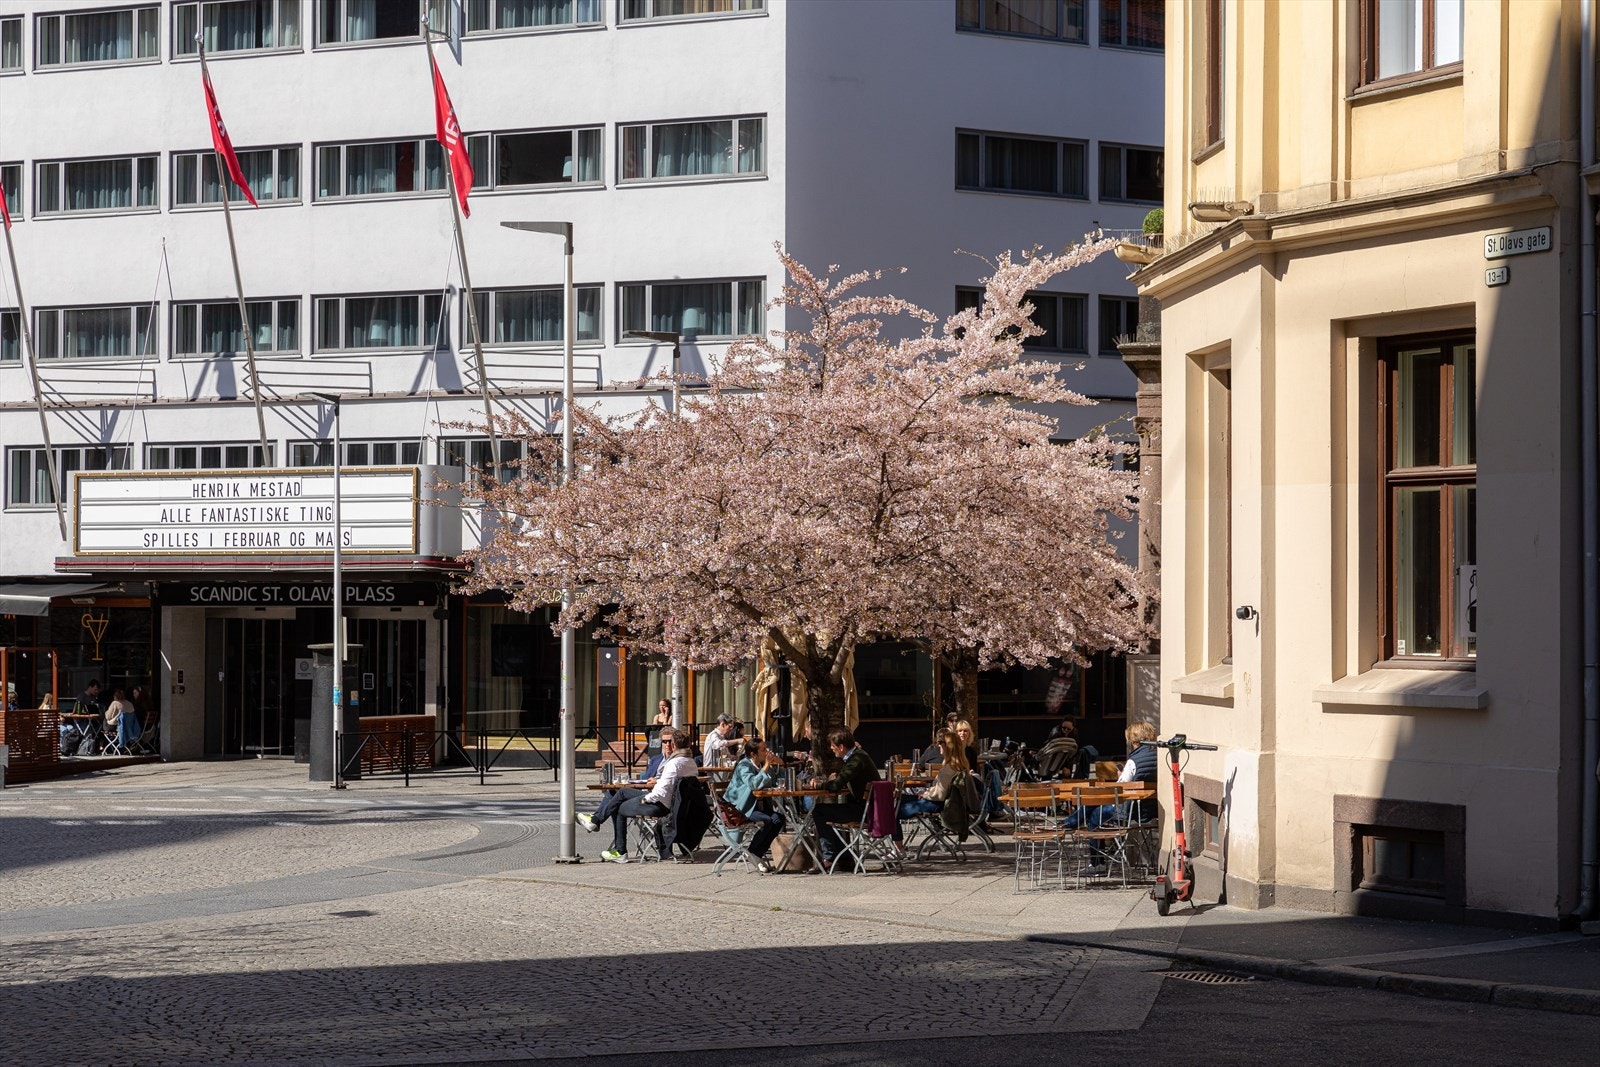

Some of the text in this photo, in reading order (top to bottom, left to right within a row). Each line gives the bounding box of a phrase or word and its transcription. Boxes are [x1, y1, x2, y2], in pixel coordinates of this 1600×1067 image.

[1488, 232, 1546, 253] St. Olavs gate
[1488, 270, 1504, 282] 13-1
[193, 482, 301, 498] HENRIK MESTAD
[161, 506, 332, 523] ALLE FANTASTISKE TING
[143, 531, 350, 547] SPILLES I FEBRUAR OG MAS
[190, 586, 257, 602] SCANDIC
[262, 586, 284, 602] ST.
[346, 586, 395, 602] PLASS
